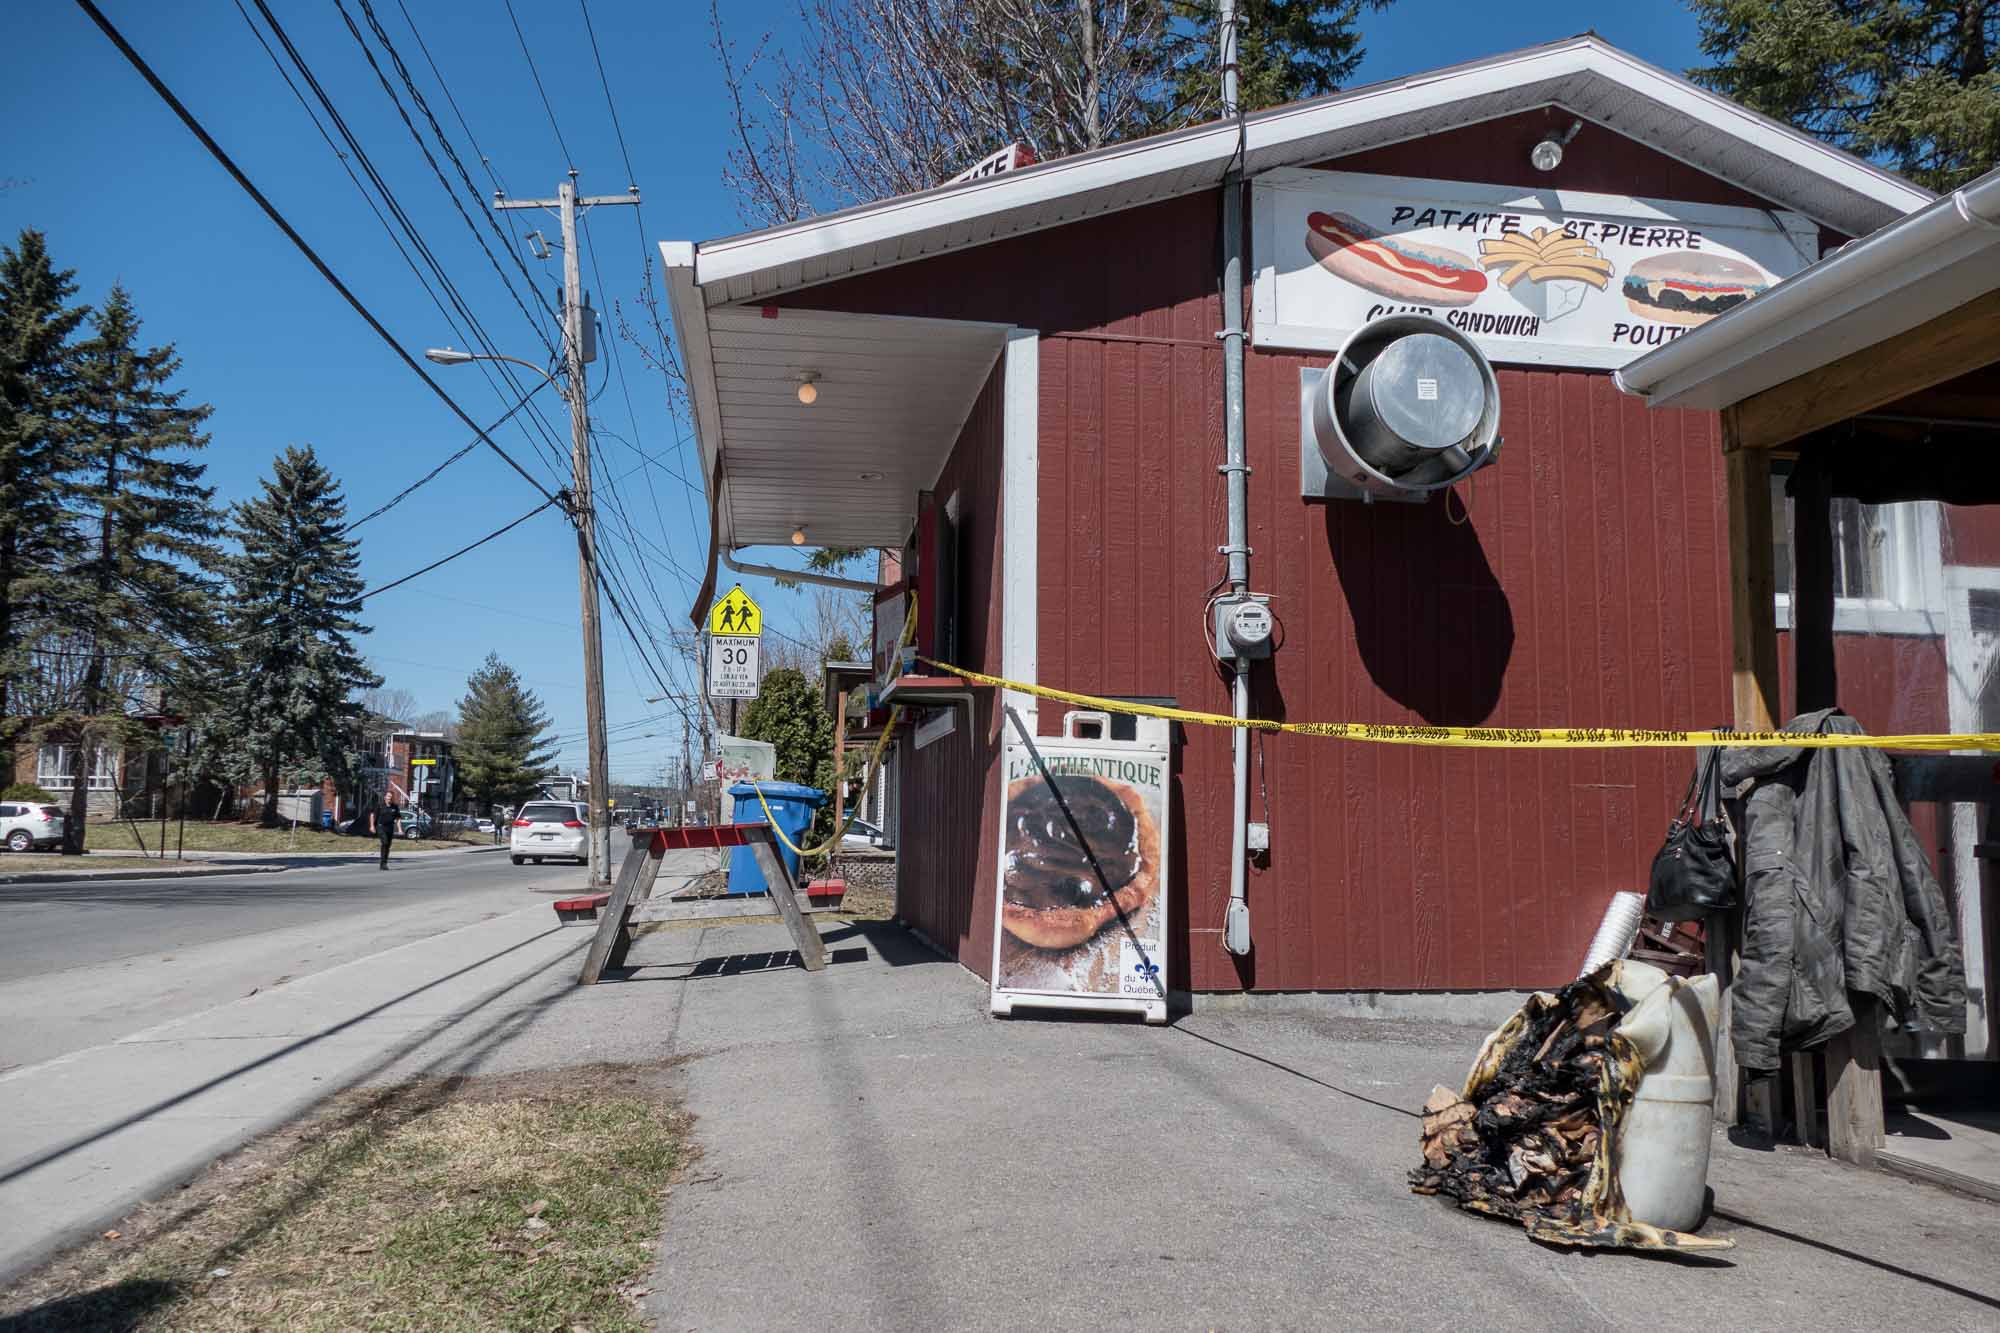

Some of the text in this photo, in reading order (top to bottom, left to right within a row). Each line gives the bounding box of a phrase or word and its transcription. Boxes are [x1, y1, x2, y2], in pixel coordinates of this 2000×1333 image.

[1391, 206, 1702, 249] PATATE ST-PIERRE
[1446, 309, 1540, 337] SANDWICH
[716, 638, 755, 647] MAXIMUM
[722, 648, 748, 665] 30
[1009, 757, 1161, 788] L'AUTHENTIQUE
[1125, 941, 1156, 951] Produit
